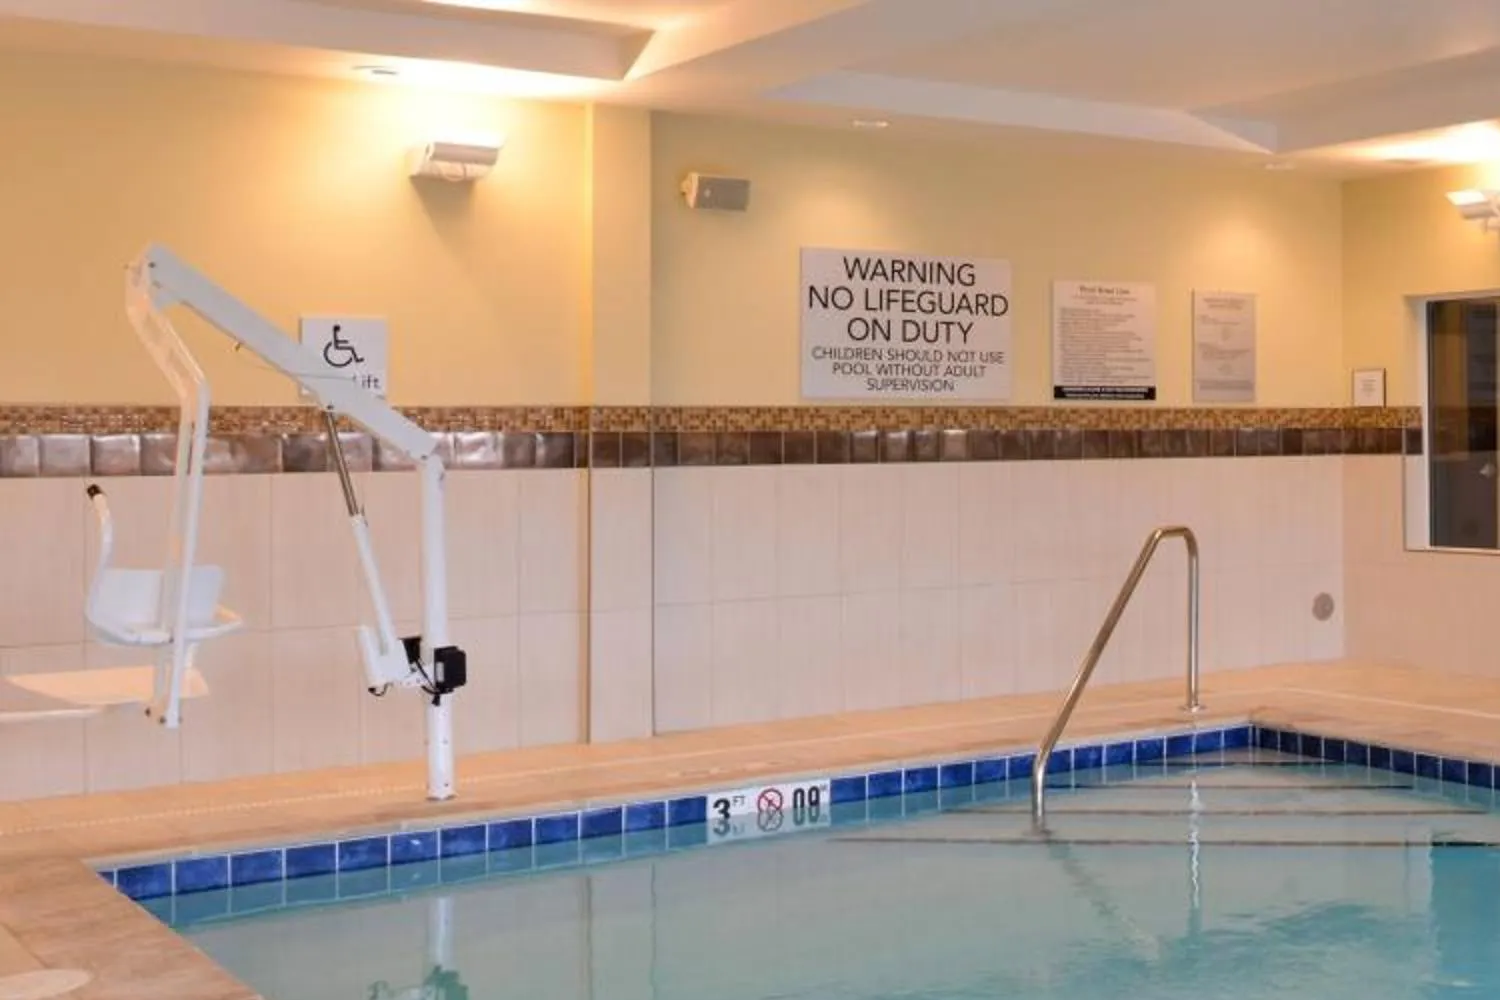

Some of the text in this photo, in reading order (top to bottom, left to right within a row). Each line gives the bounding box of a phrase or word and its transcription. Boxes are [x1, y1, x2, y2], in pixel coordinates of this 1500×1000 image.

[843, 256, 976, 287] WARNING
[808, 285, 1009, 317] NO LIFEGUARD
[847, 317, 974, 344] ON DUTY
[812, 346, 1005, 365] CHILDREN SHOULD NOT USE
[832, 362, 987, 379] POOL WITHOUT ADULT
[353, 374, 381, 389] ift
[867, 378, 954, 392] SUPERVISION
[713, 797, 730, 820] 3
